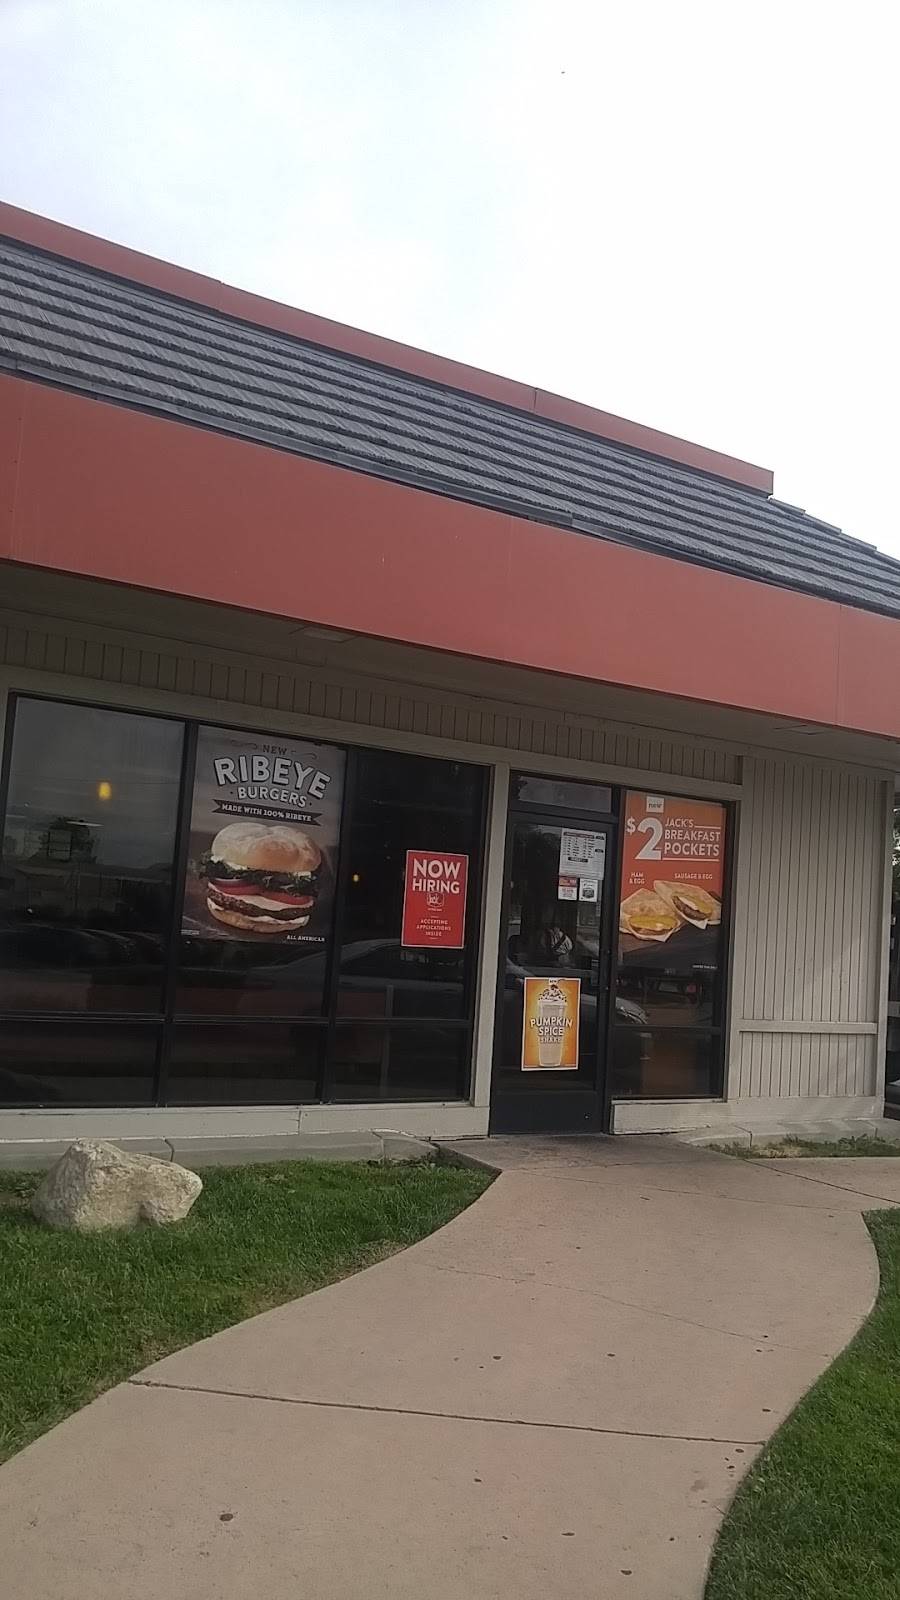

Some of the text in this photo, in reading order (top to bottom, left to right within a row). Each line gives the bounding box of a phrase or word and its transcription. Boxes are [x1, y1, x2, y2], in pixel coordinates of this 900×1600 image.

[262, 744, 287, 755] NEW
[214, 755, 331, 799] RIBEYE
[237, 786, 308, 808] BURGERS
[222, 804, 312, 821] MADE WITH 100% RIBEYE
[664, 817, 694, 828] JACK'S
[664, 829, 721, 842] BREAKFAST
[664, 842, 720, 856] POCKETS
[413, 858, 461, 879] NOW
[674, 872, 697, 880] SAUSAGE
[412, 877, 460, 894] HIRING
[530, 1016, 573, 1028] PUMPKIN
[538, 1026, 564, 1036] SPICE
